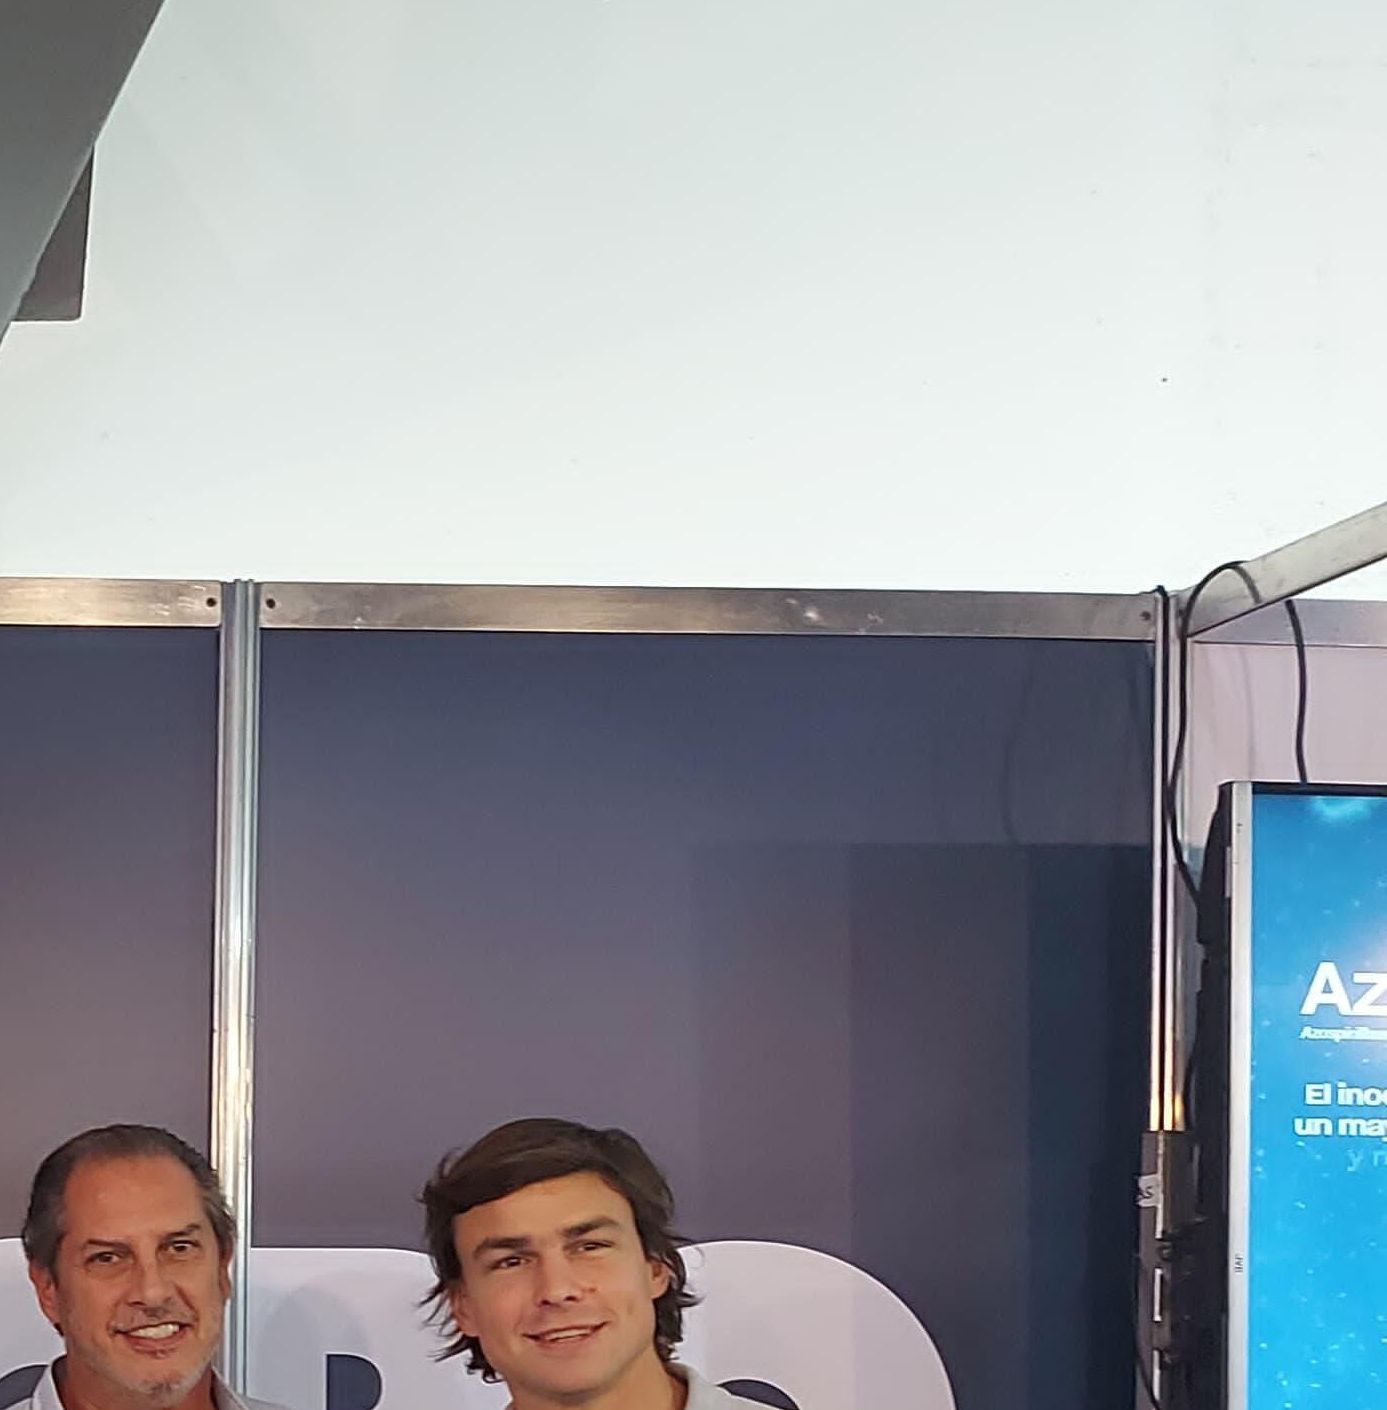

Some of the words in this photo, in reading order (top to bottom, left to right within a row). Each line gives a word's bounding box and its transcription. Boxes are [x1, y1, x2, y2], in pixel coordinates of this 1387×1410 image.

[1305, 1083, 1332, 1105] El
[1337, 1081, 1387, 1106] ino
[1294, 1118, 1333, 1136] un
